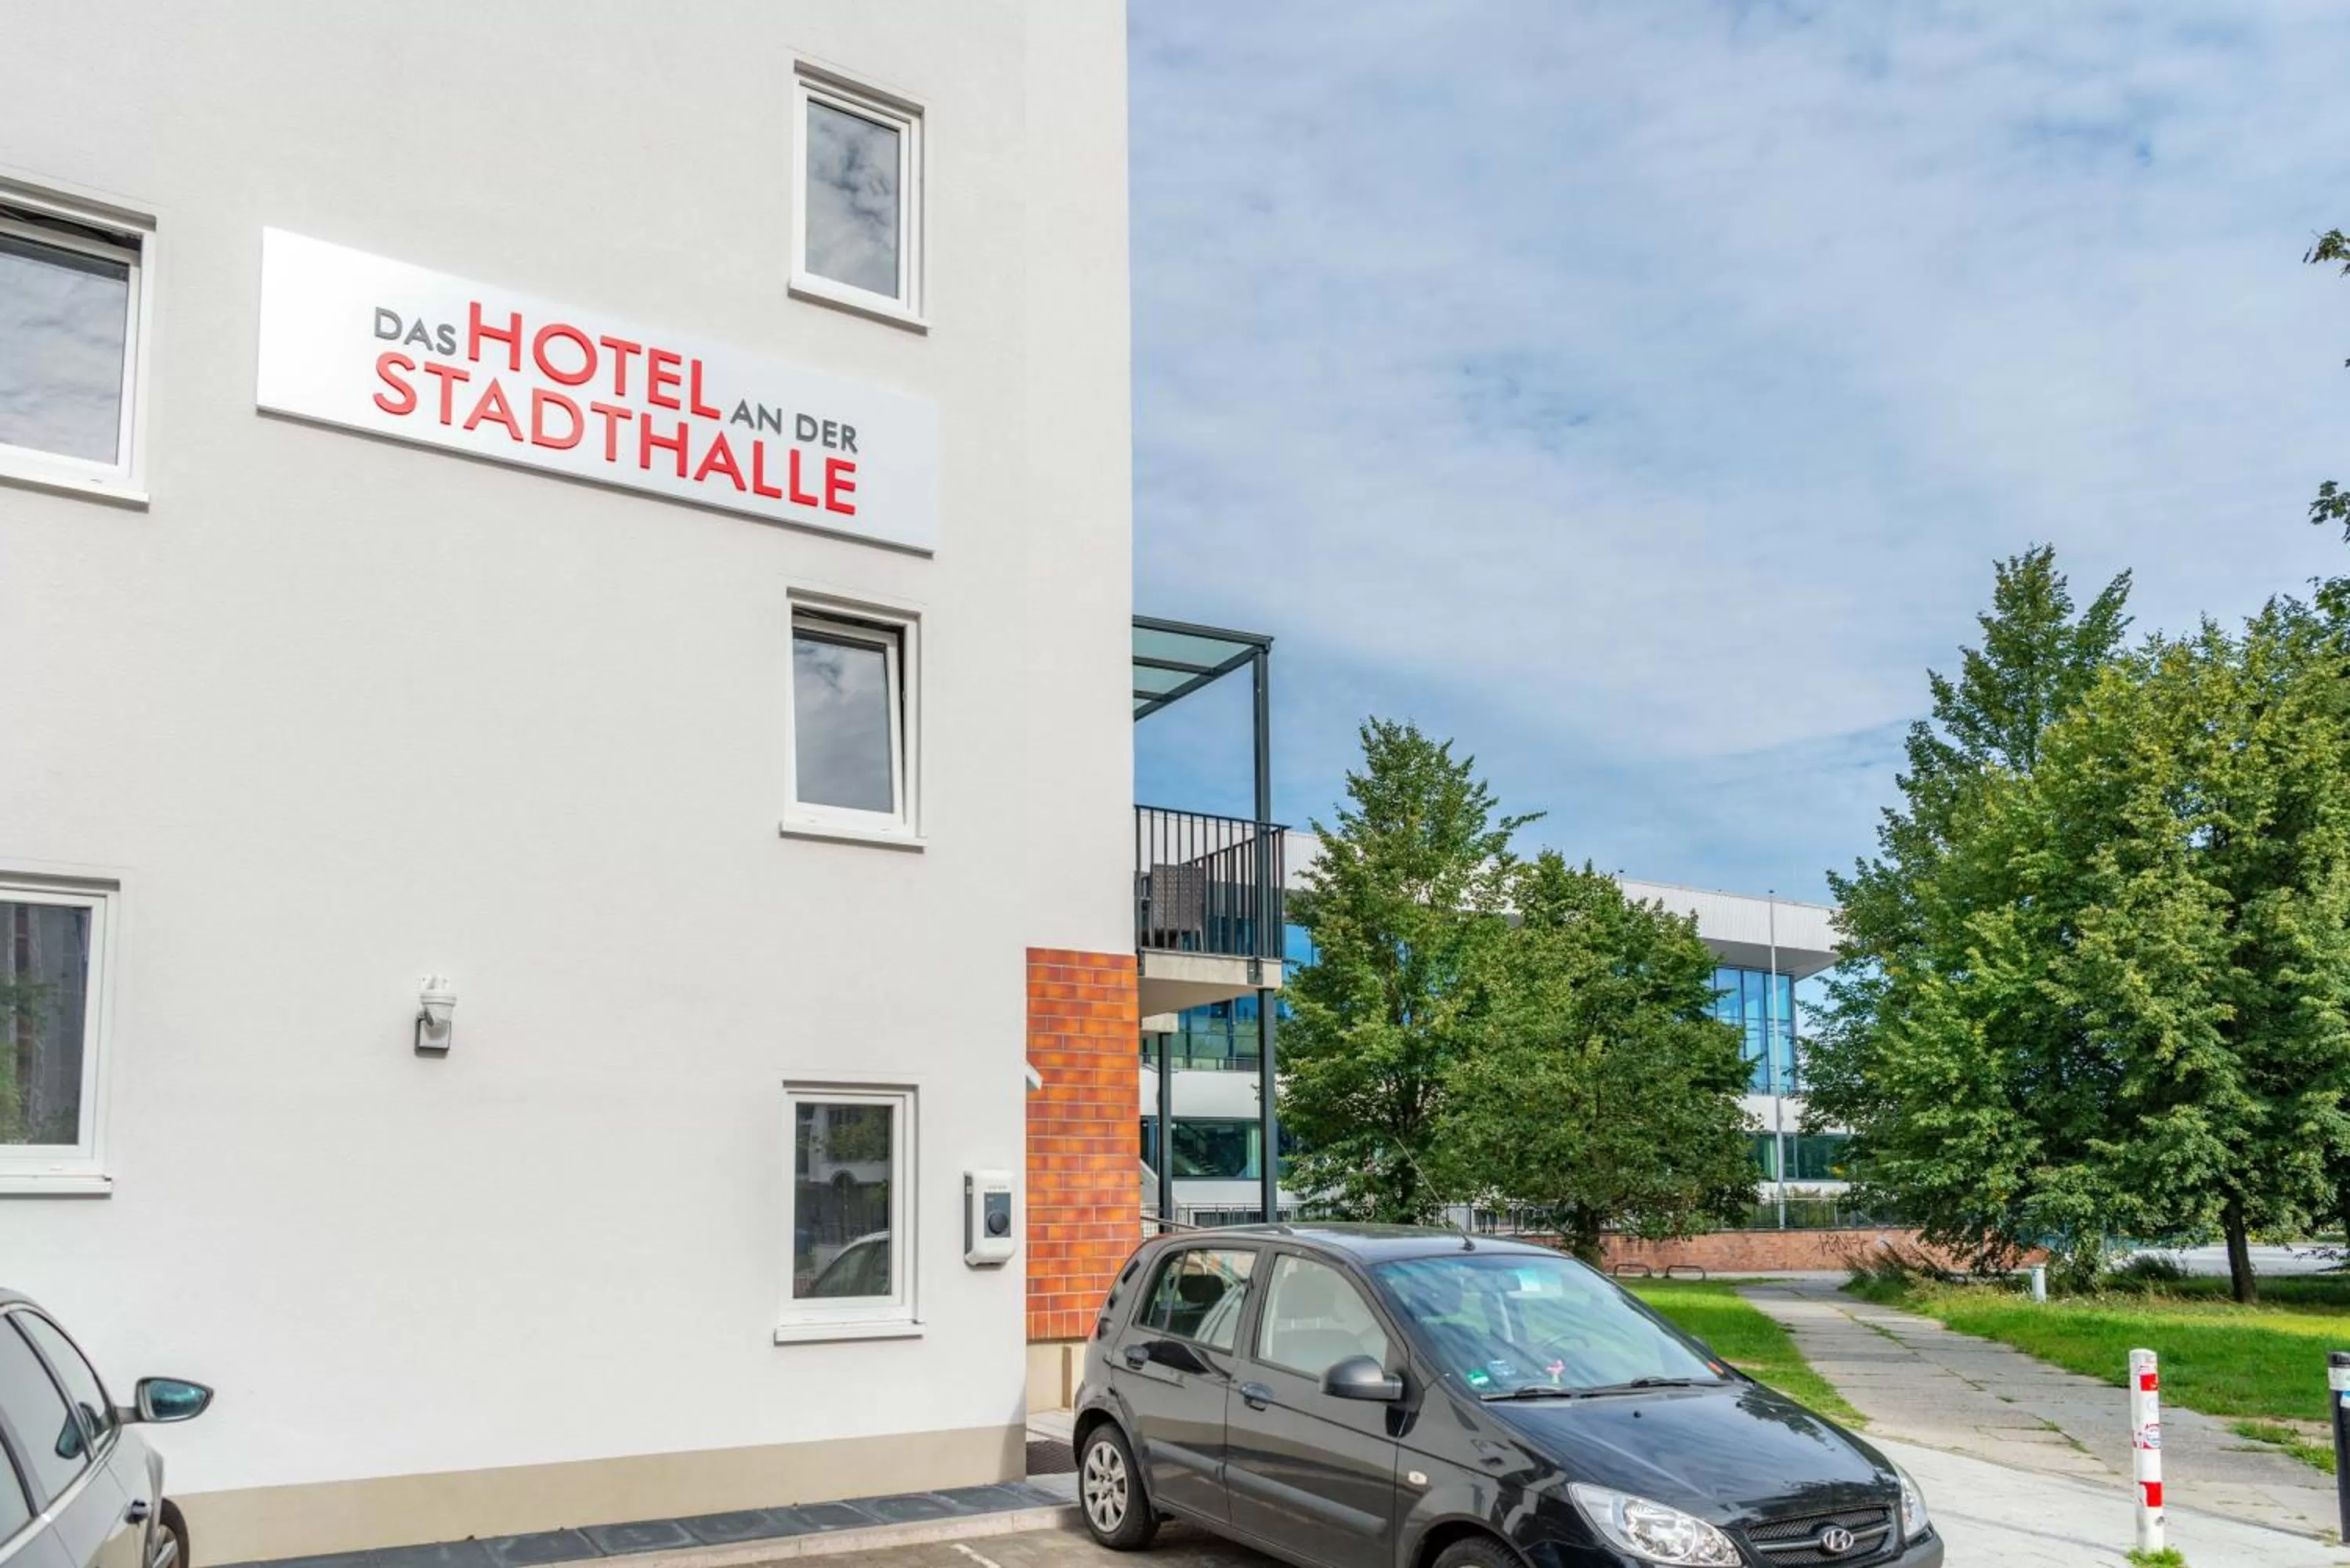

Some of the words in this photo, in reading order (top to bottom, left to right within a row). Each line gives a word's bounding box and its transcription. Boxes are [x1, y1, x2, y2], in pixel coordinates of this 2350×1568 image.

[373, 352, 857, 515] STADTHALLE
[374, 306, 457, 356] DAS
[468, 301, 721, 421] HOTEL
[729, 399, 783, 435] AN
[795, 414, 859, 454] DER
